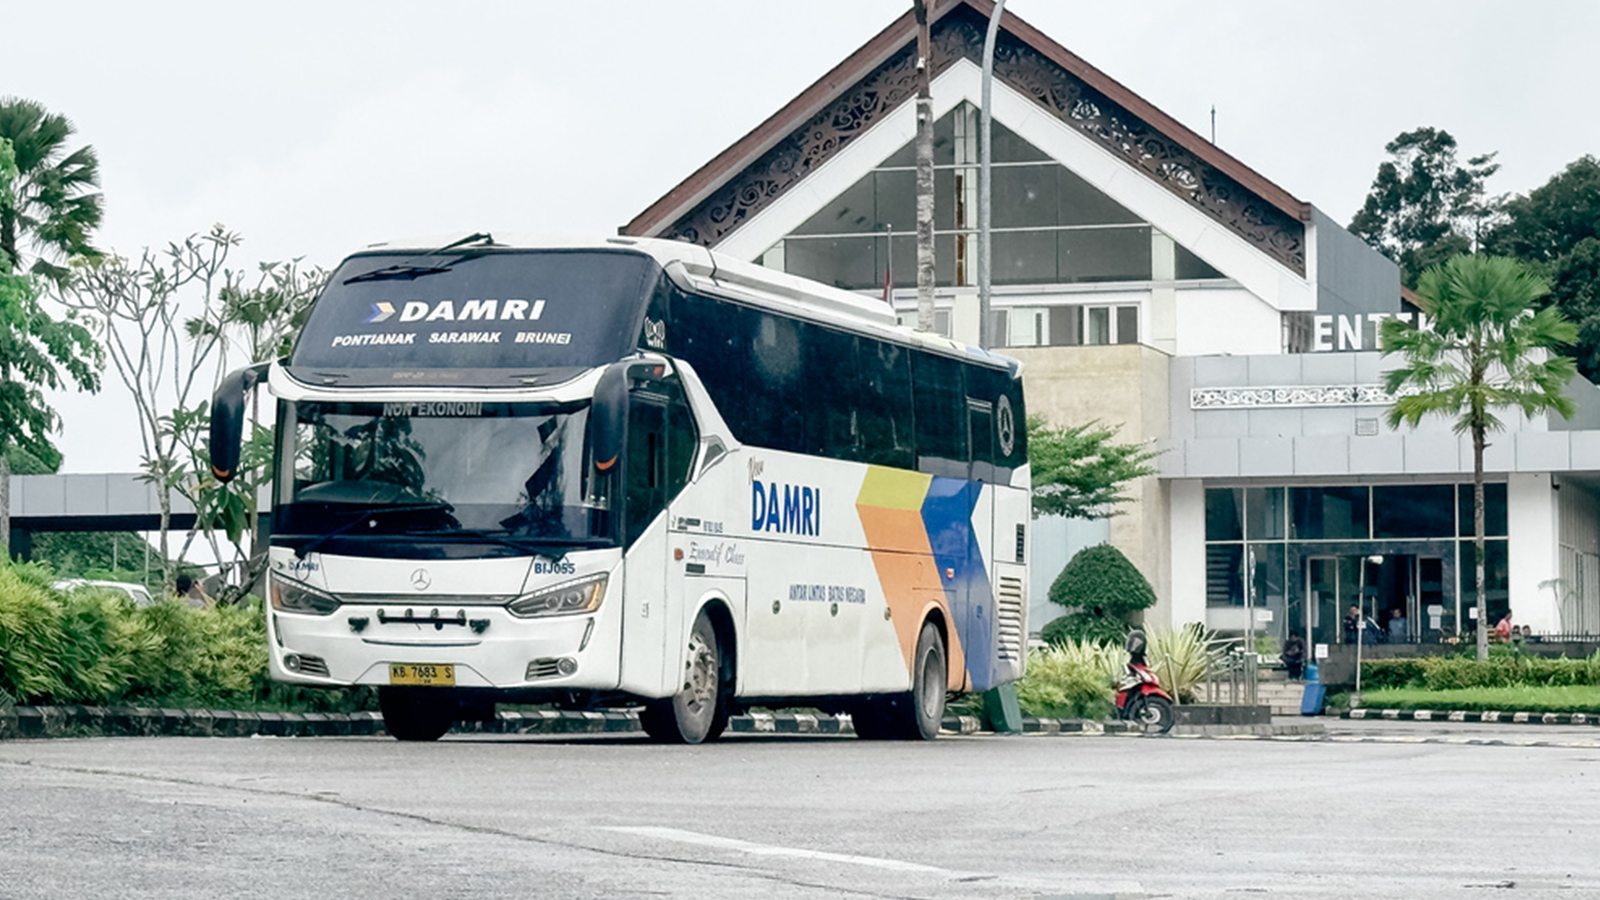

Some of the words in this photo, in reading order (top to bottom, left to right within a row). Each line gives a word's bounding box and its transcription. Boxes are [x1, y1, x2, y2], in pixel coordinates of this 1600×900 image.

[399, 299, 547, 323] DAMRI
[1313, 309, 1535, 351] ENTKN
[332, 333, 416, 347] PONTIANAK
[428, 331, 502, 344] SARAWAK
[514, 332, 572, 345] BRUNEI
[383, 402, 413, 417] NON
[418, 401, 483, 416] EKONOMI
[751, 480, 820, 537] DAMRI
[534, 562, 576, 574] BIJ055
[393, 666, 406, 678] KB
[411, 666, 438, 678] 7683
[445, 667, 452, 678] S
